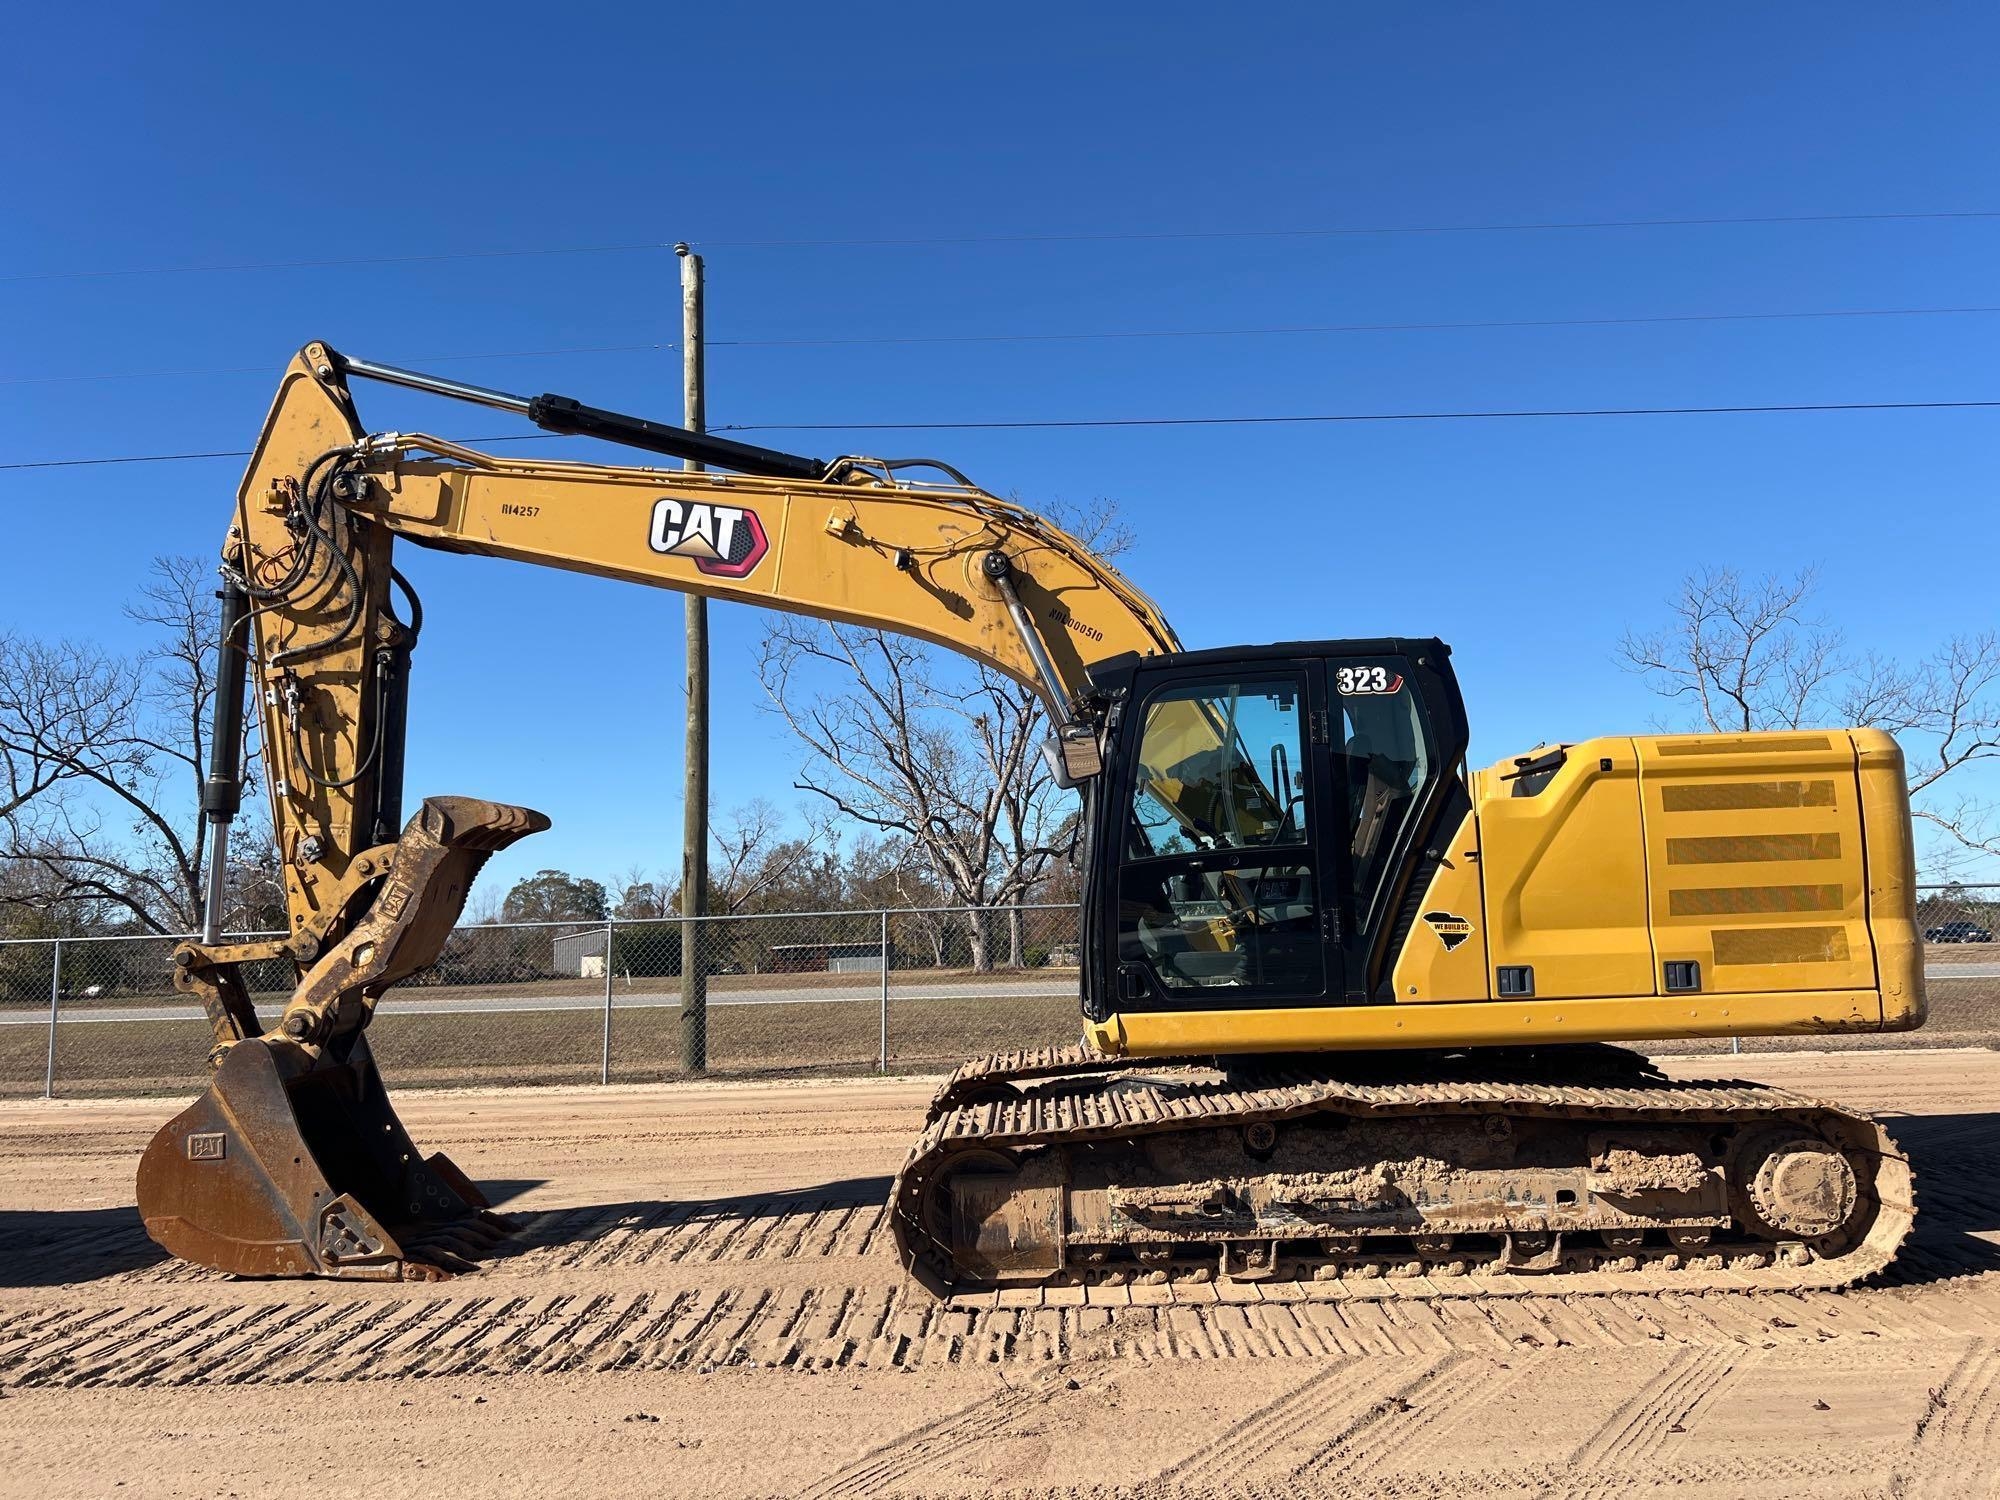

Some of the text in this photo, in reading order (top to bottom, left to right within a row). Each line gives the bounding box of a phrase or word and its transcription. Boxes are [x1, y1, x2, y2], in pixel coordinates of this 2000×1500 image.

[501, 503, 540, 517] R14257
[650, 499, 743, 560] CAT
[1339, 666, 1388, 693] 323
[383, 887, 408, 917] CAT
[1444, 923, 1461, 931] BUILD
[1460, 923, 1470, 931] SC
[193, 1137, 222, 1157] CAT
